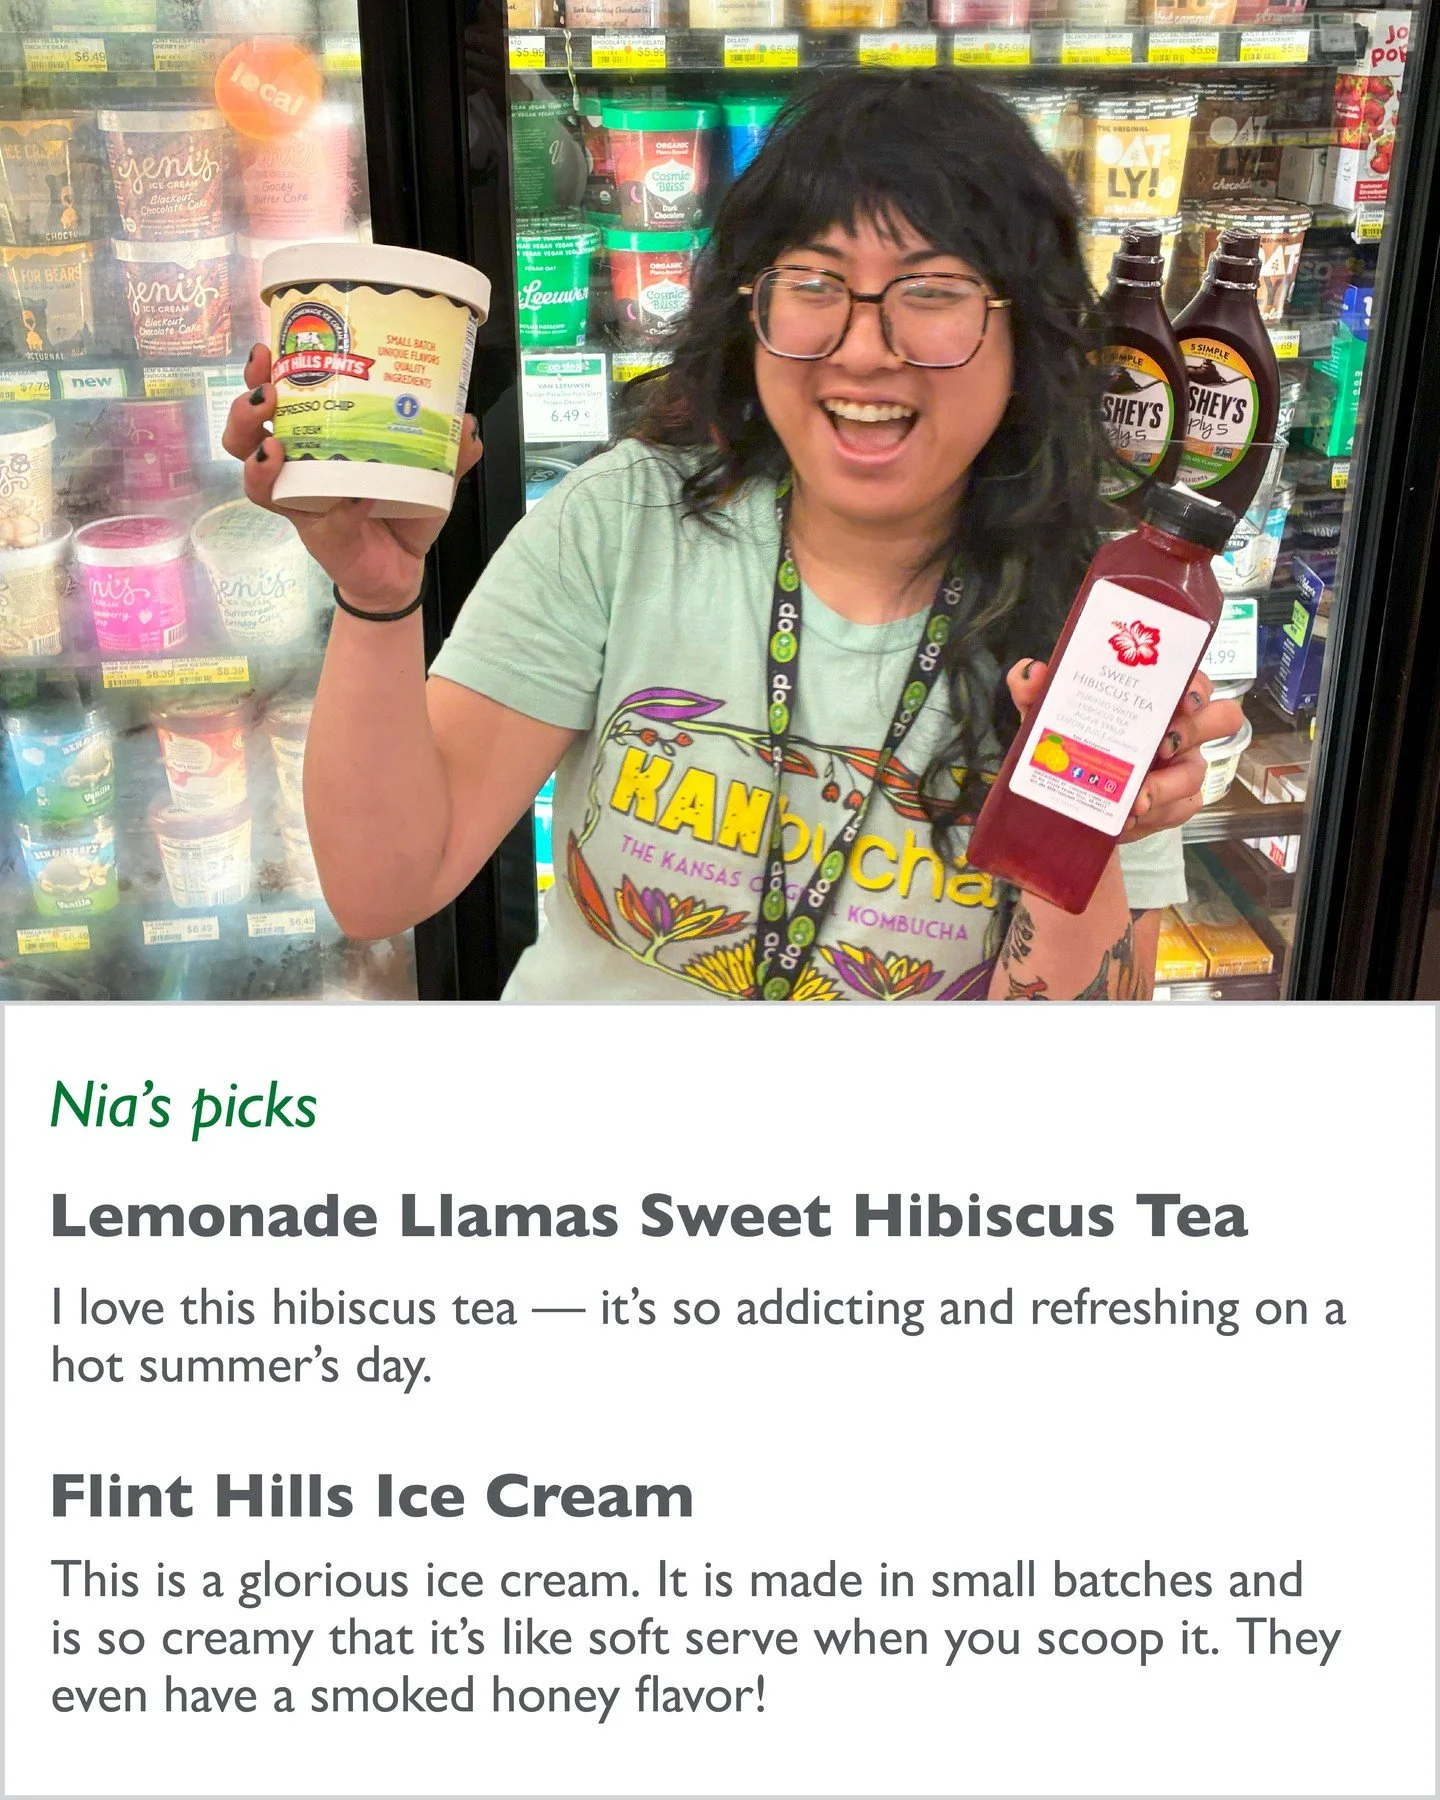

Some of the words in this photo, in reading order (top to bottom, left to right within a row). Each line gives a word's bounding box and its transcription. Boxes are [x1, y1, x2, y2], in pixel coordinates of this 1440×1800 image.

[516, 47, 545, 57] $5.99
[637, 47, 666, 57] $5.99
[769, 45, 798, 54] $5.99
[74, 51, 106, 62] $6.49
[229, 61, 305, 117] local
[118, 145, 220, 195] jeni's
[652, 170, 690, 182] Cosmic
[149, 181, 165, 189] ICE
[166, 180, 199, 189] CREAM
[262, 181, 294, 193] Gooey
[656, 181, 685, 192] Bliss
[1107, 167, 1160, 199] LY!
[150, 192, 194, 205] Blackout
[283, 192, 309, 204] Cake
[141, 204, 184, 215] Chocolate
[187, 199, 209, 211] Cake
[662, 203, 679, 212] Dark
[654, 211, 685, 220] Chocolate
[21, 269, 42, 283] FOR
[44, 266, 82, 282] BEARS
[126, 271, 219, 316] jeni's
[646, 289, 684, 300] Cosmic
[142, 305, 156, 313] ICE
[157, 305, 190, 313] CREAM
[144, 316, 185, 327] Blackout
[139, 326, 174, 336] Chocolate
[178, 323, 202, 335] Cake
[386, 334, 413, 348] SMALL
[414, 339, 436, 351] BATCH
[377, 346, 411, 360] UNIQUE
[410, 350, 441, 366] FLAVORS
[1190, 343, 1196, 351] 5
[1196, 344, 1230, 360] SIMPLE
[291, 353, 322, 371] HILLS
[323, 354, 367, 375] PINTS
[393, 361, 426, 374] QUALITY
[71, 376, 113, 388] new
[383, 372, 433, 388] INGREDIENTS
[20, 382, 50, 393] $7.79
[1189, 386, 1248, 425] SHEY'S
[551, 409, 580, 423] 6.49
[1103, 396, 1164, 429] SHEY'S
[1134, 429, 1147, 440] 5
[1216, 423, 1229, 436] 5
[224, 605, 277, 618] Buttercream
[224, 617, 257, 629] Birthday
[146, 670, 174, 679] $8.39
[216, 667, 244, 676] $8.39
[1099, 664, 1141, 689] SWEET
[1073, 670, 1130, 702] HIBISCUS
[1132, 694, 1154, 713] TEA
[1077, 701, 1115, 722] HIBISCUS
[1114, 717, 1129, 727] TEA
[1112, 705, 1138, 721] WATER
[1056, 712, 1085, 730] LEMON
[622, 834, 657, 864] THE
[660, 850, 743, 888] KANSAS
[57, 898, 92, 909] Vanilla
[289, 917, 314, 926] $6.49
[847, 904, 969, 942] KOMBUCHA
[186, 924, 213, 934] $6.49
